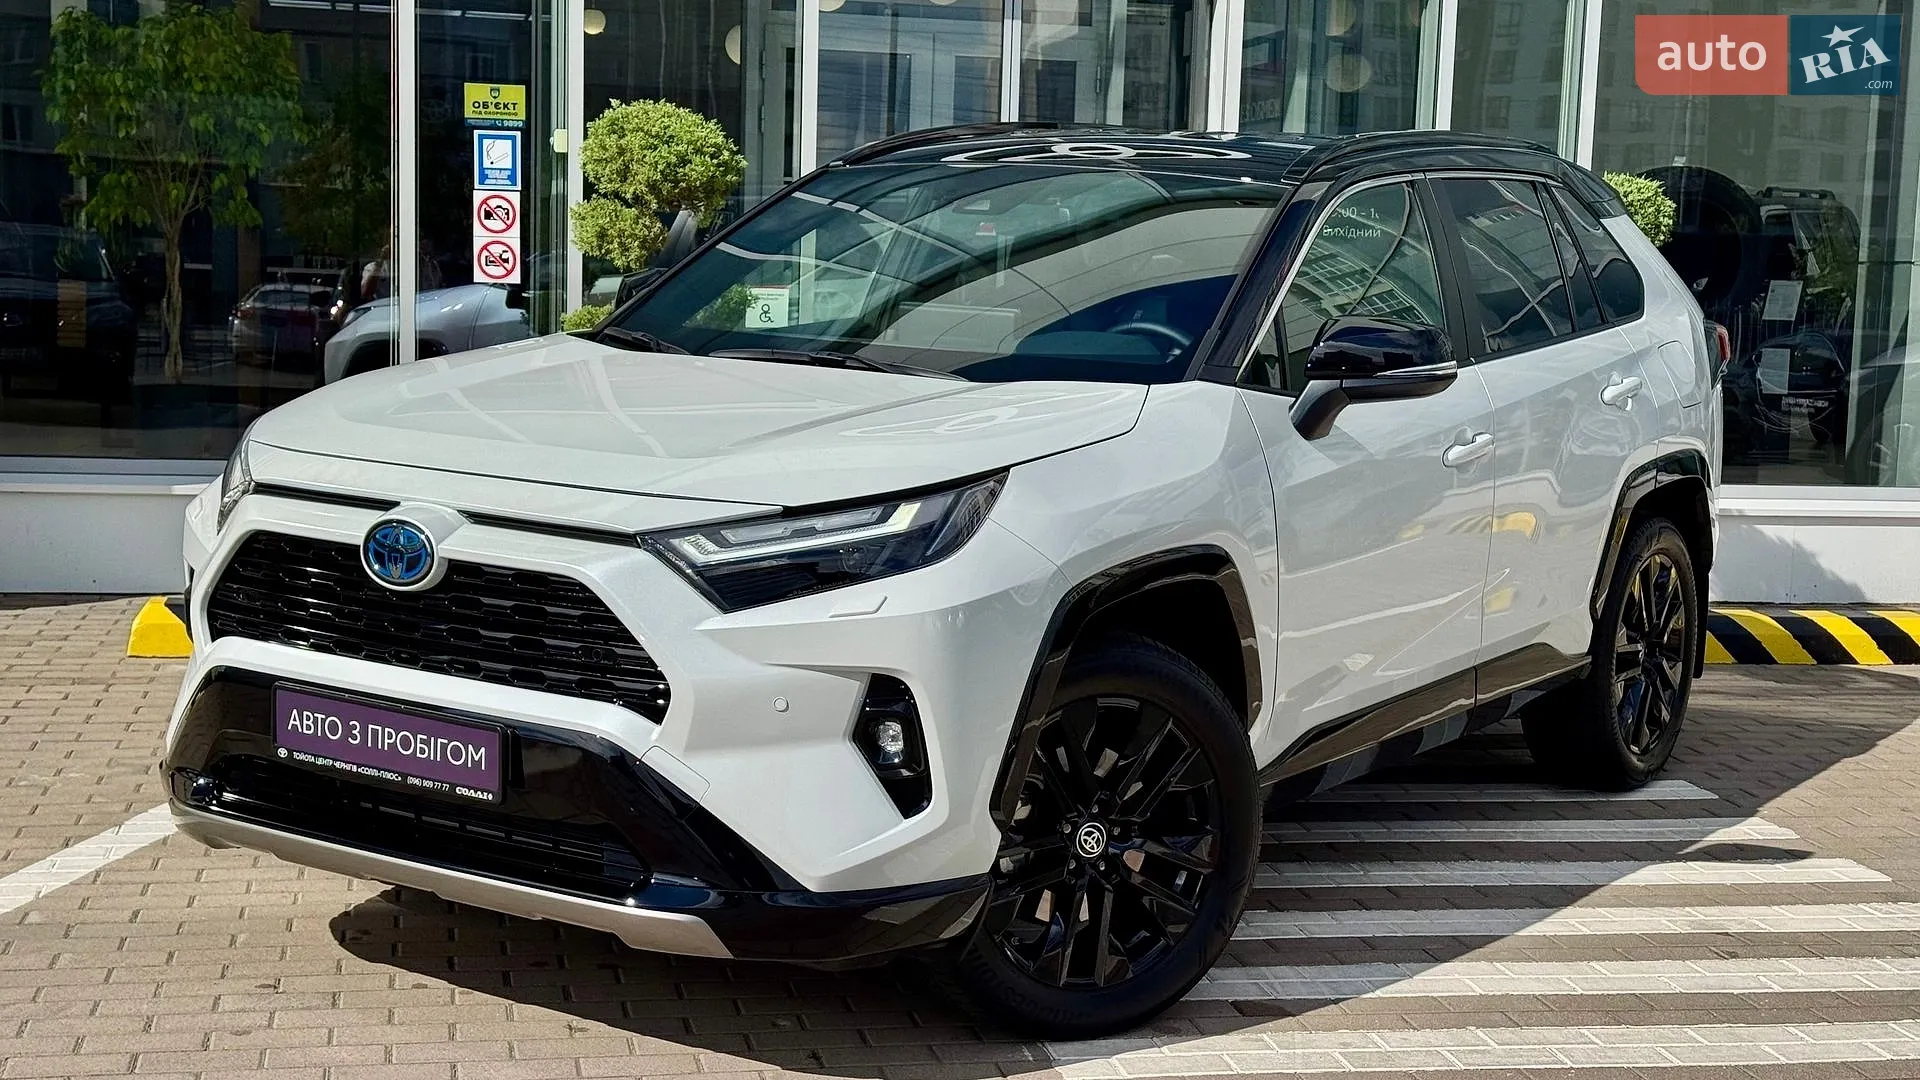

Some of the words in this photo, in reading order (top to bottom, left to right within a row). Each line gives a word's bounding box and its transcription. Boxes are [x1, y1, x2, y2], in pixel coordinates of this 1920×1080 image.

[287, 708, 342, 740] АВТО
[367, 724, 486, 771] ПРОБІГОМ
[293, 751, 315, 763] ТОЙОТА
[316, 757, 333, 767] ЦЕНТР
[333, 760, 358, 773] ЧЕРНІГІВ
[407, 775, 422, 787] (096)
[422, 779, 434, 788] 909
[434, 782, 442, 790] 77
[442, 783, 450, 791] 77
